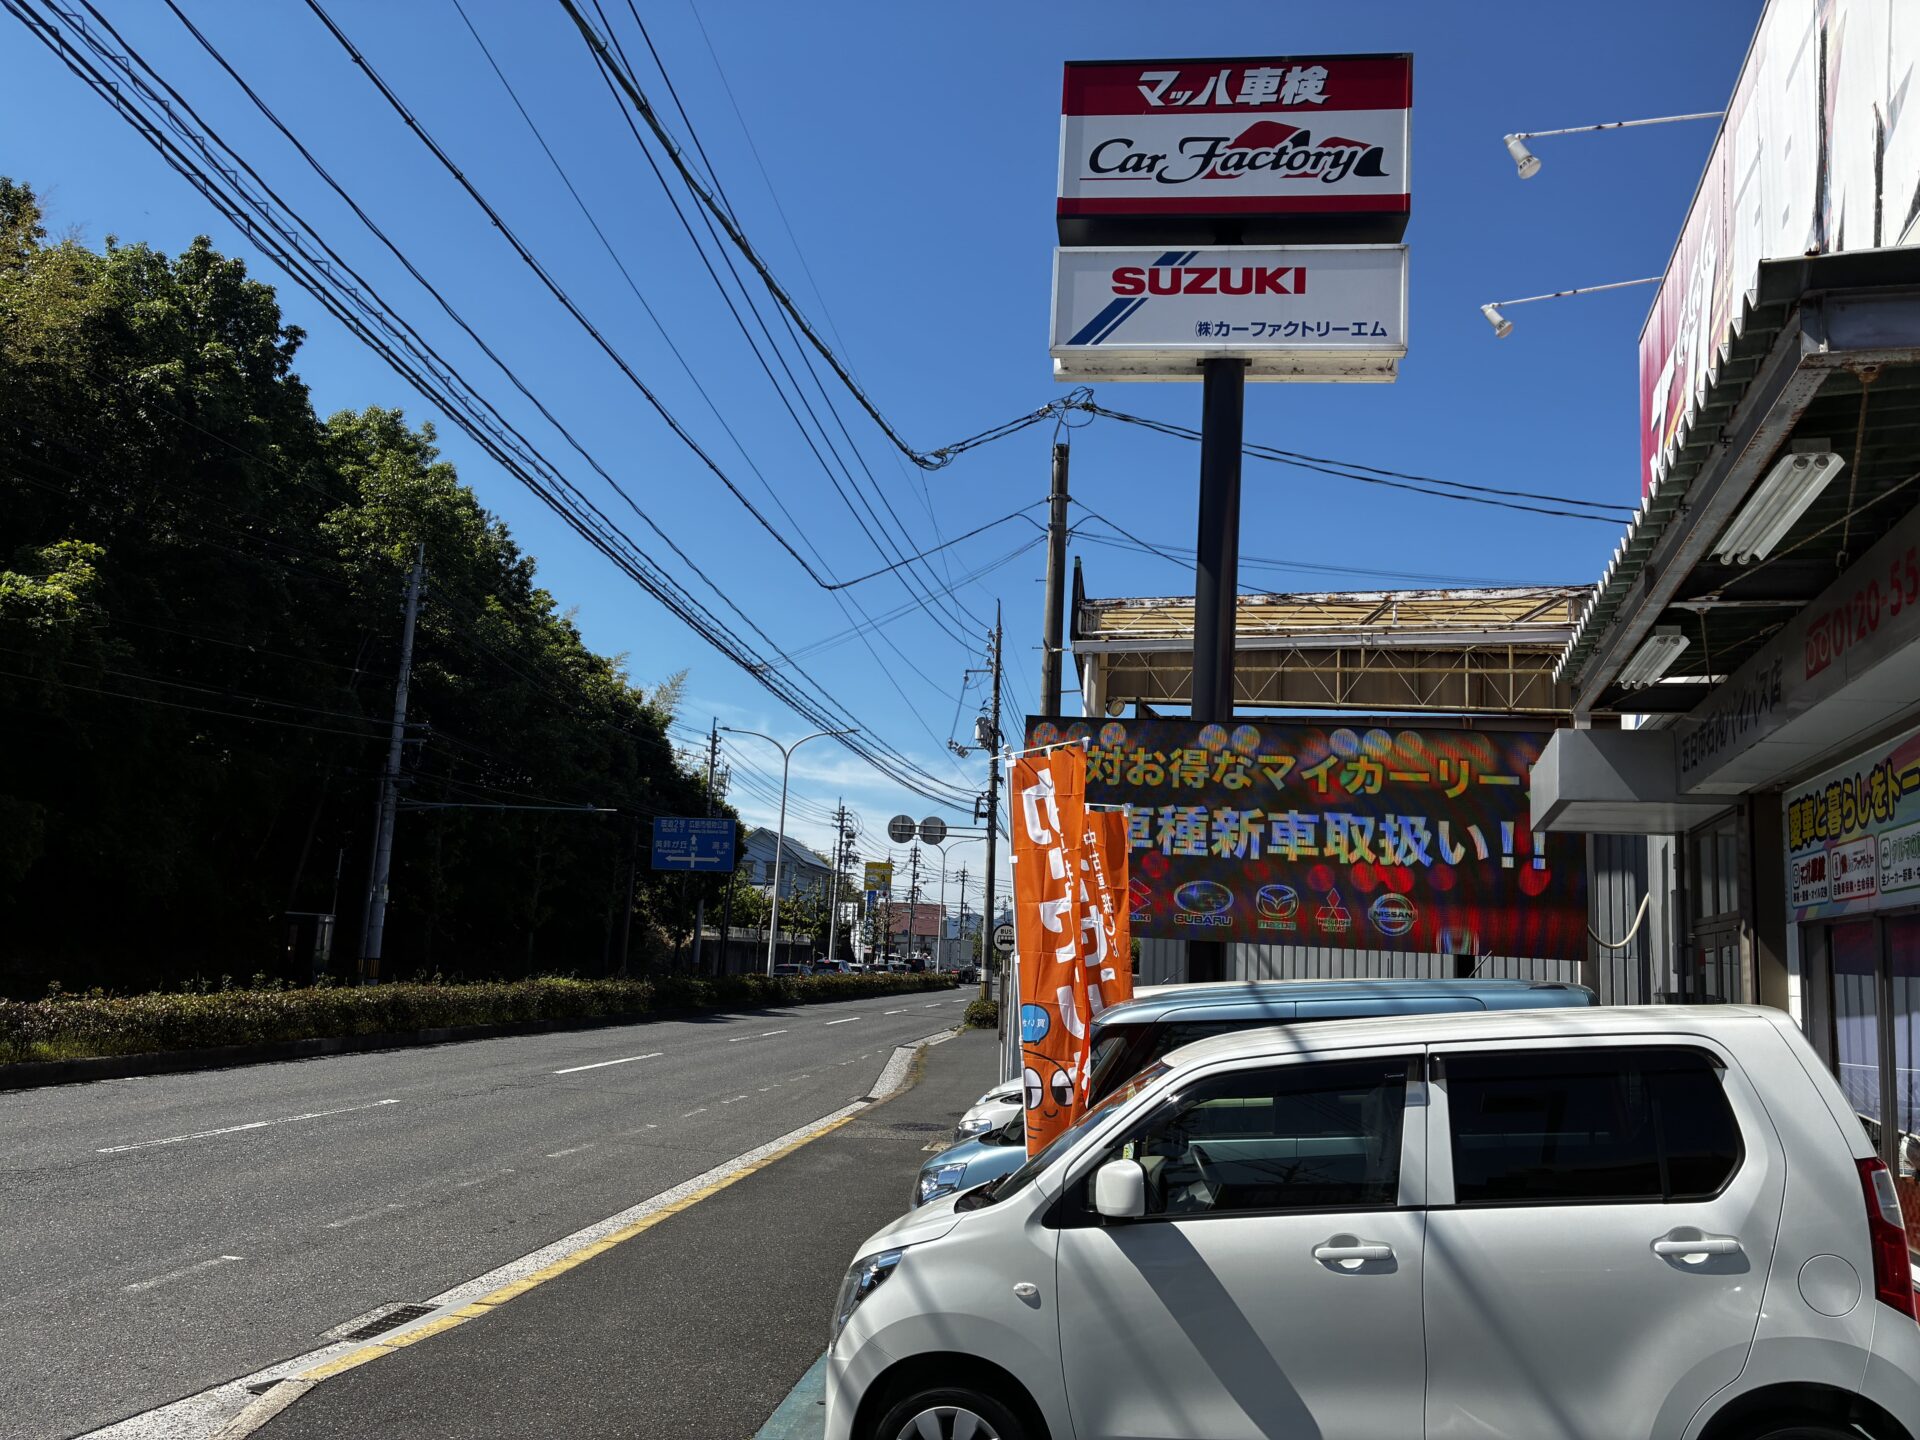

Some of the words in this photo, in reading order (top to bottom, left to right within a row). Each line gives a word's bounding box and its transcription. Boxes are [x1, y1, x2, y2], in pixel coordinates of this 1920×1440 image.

[1137, 65, 1331, 107] マッハ車検
[1089, 138, 1166, 174] Car
[1156, 136, 1369, 184] Factory
[1112, 267, 1306, 295] SUZUKI
[1087, 745, 1531, 801] 対お得なマイカーリー
[1174, 914, 1232, 926] SUBARU
[1374, 910, 1413, 919] NISSAN
